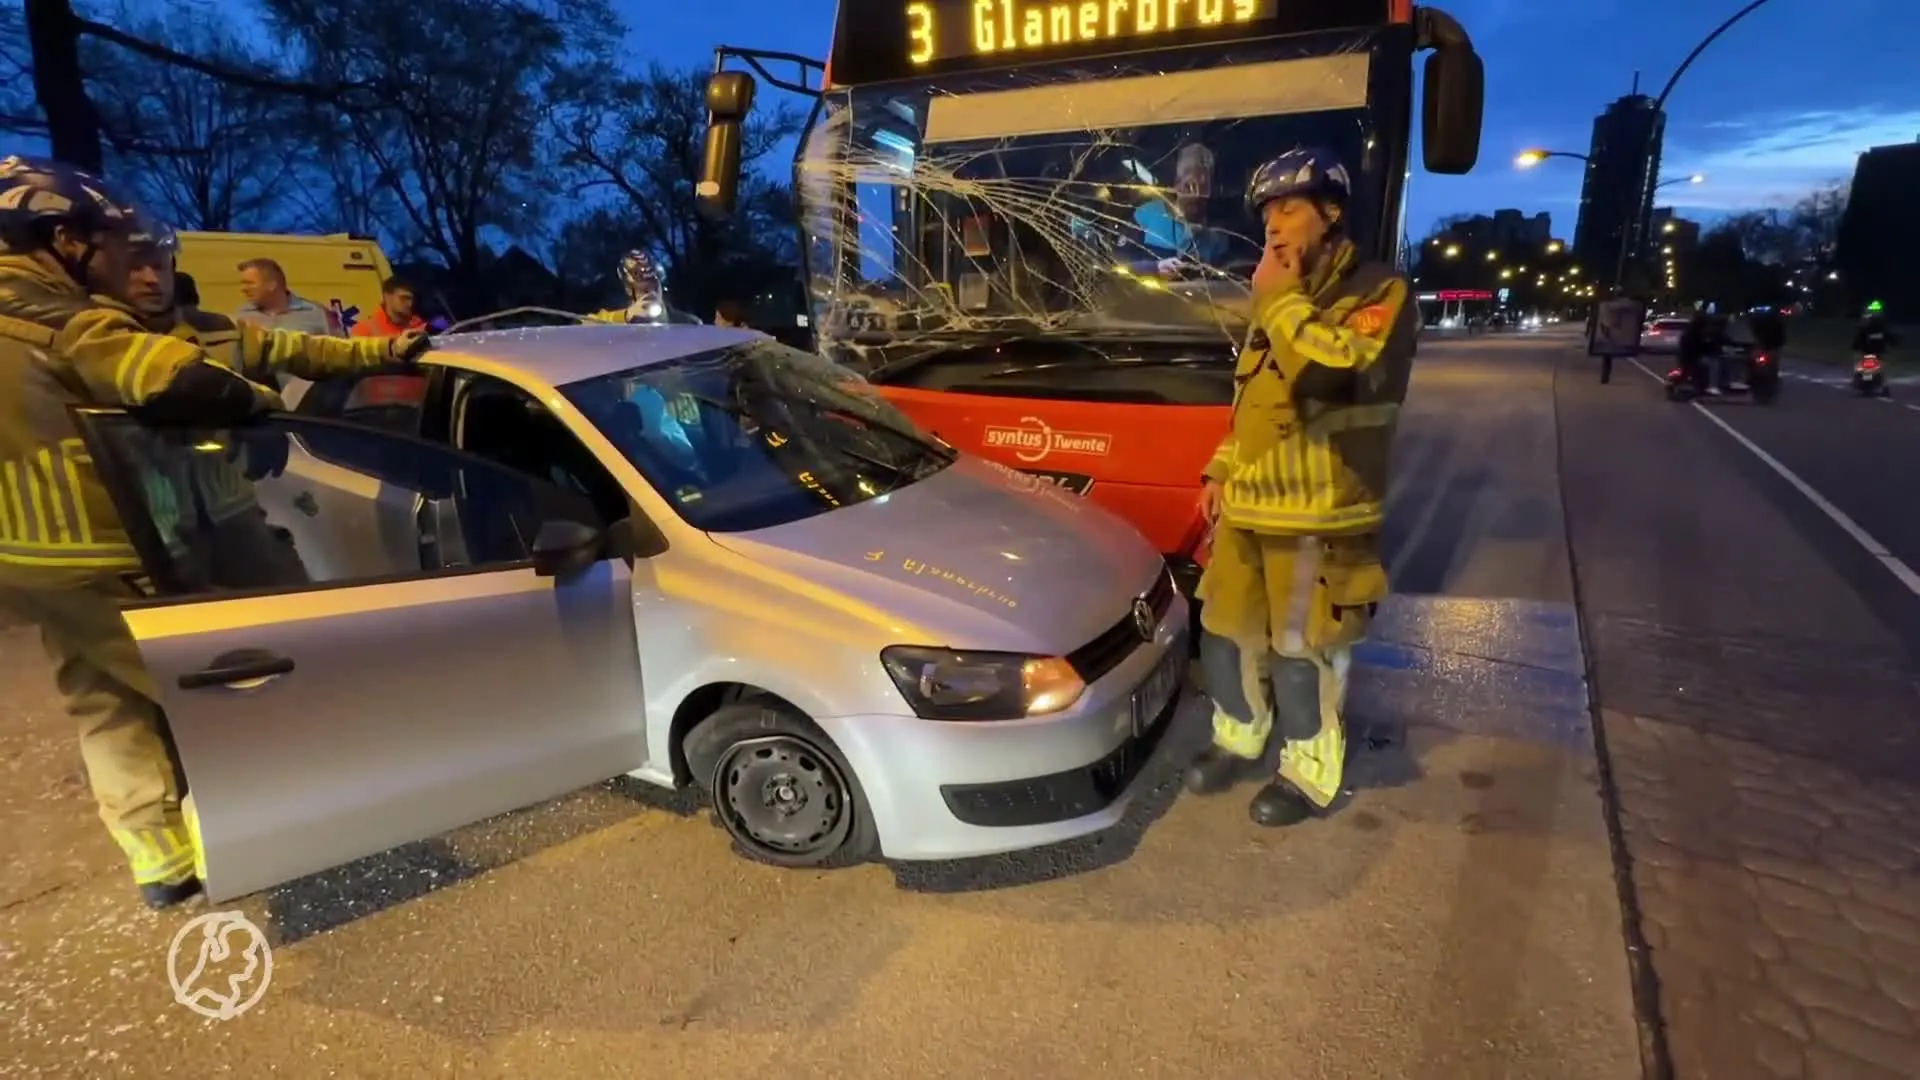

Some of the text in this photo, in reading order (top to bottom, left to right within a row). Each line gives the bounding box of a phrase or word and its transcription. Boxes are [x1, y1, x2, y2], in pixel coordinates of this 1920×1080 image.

[906, 3, 934, 64] 3
[987, 428, 1106, 452] syntus Twente
